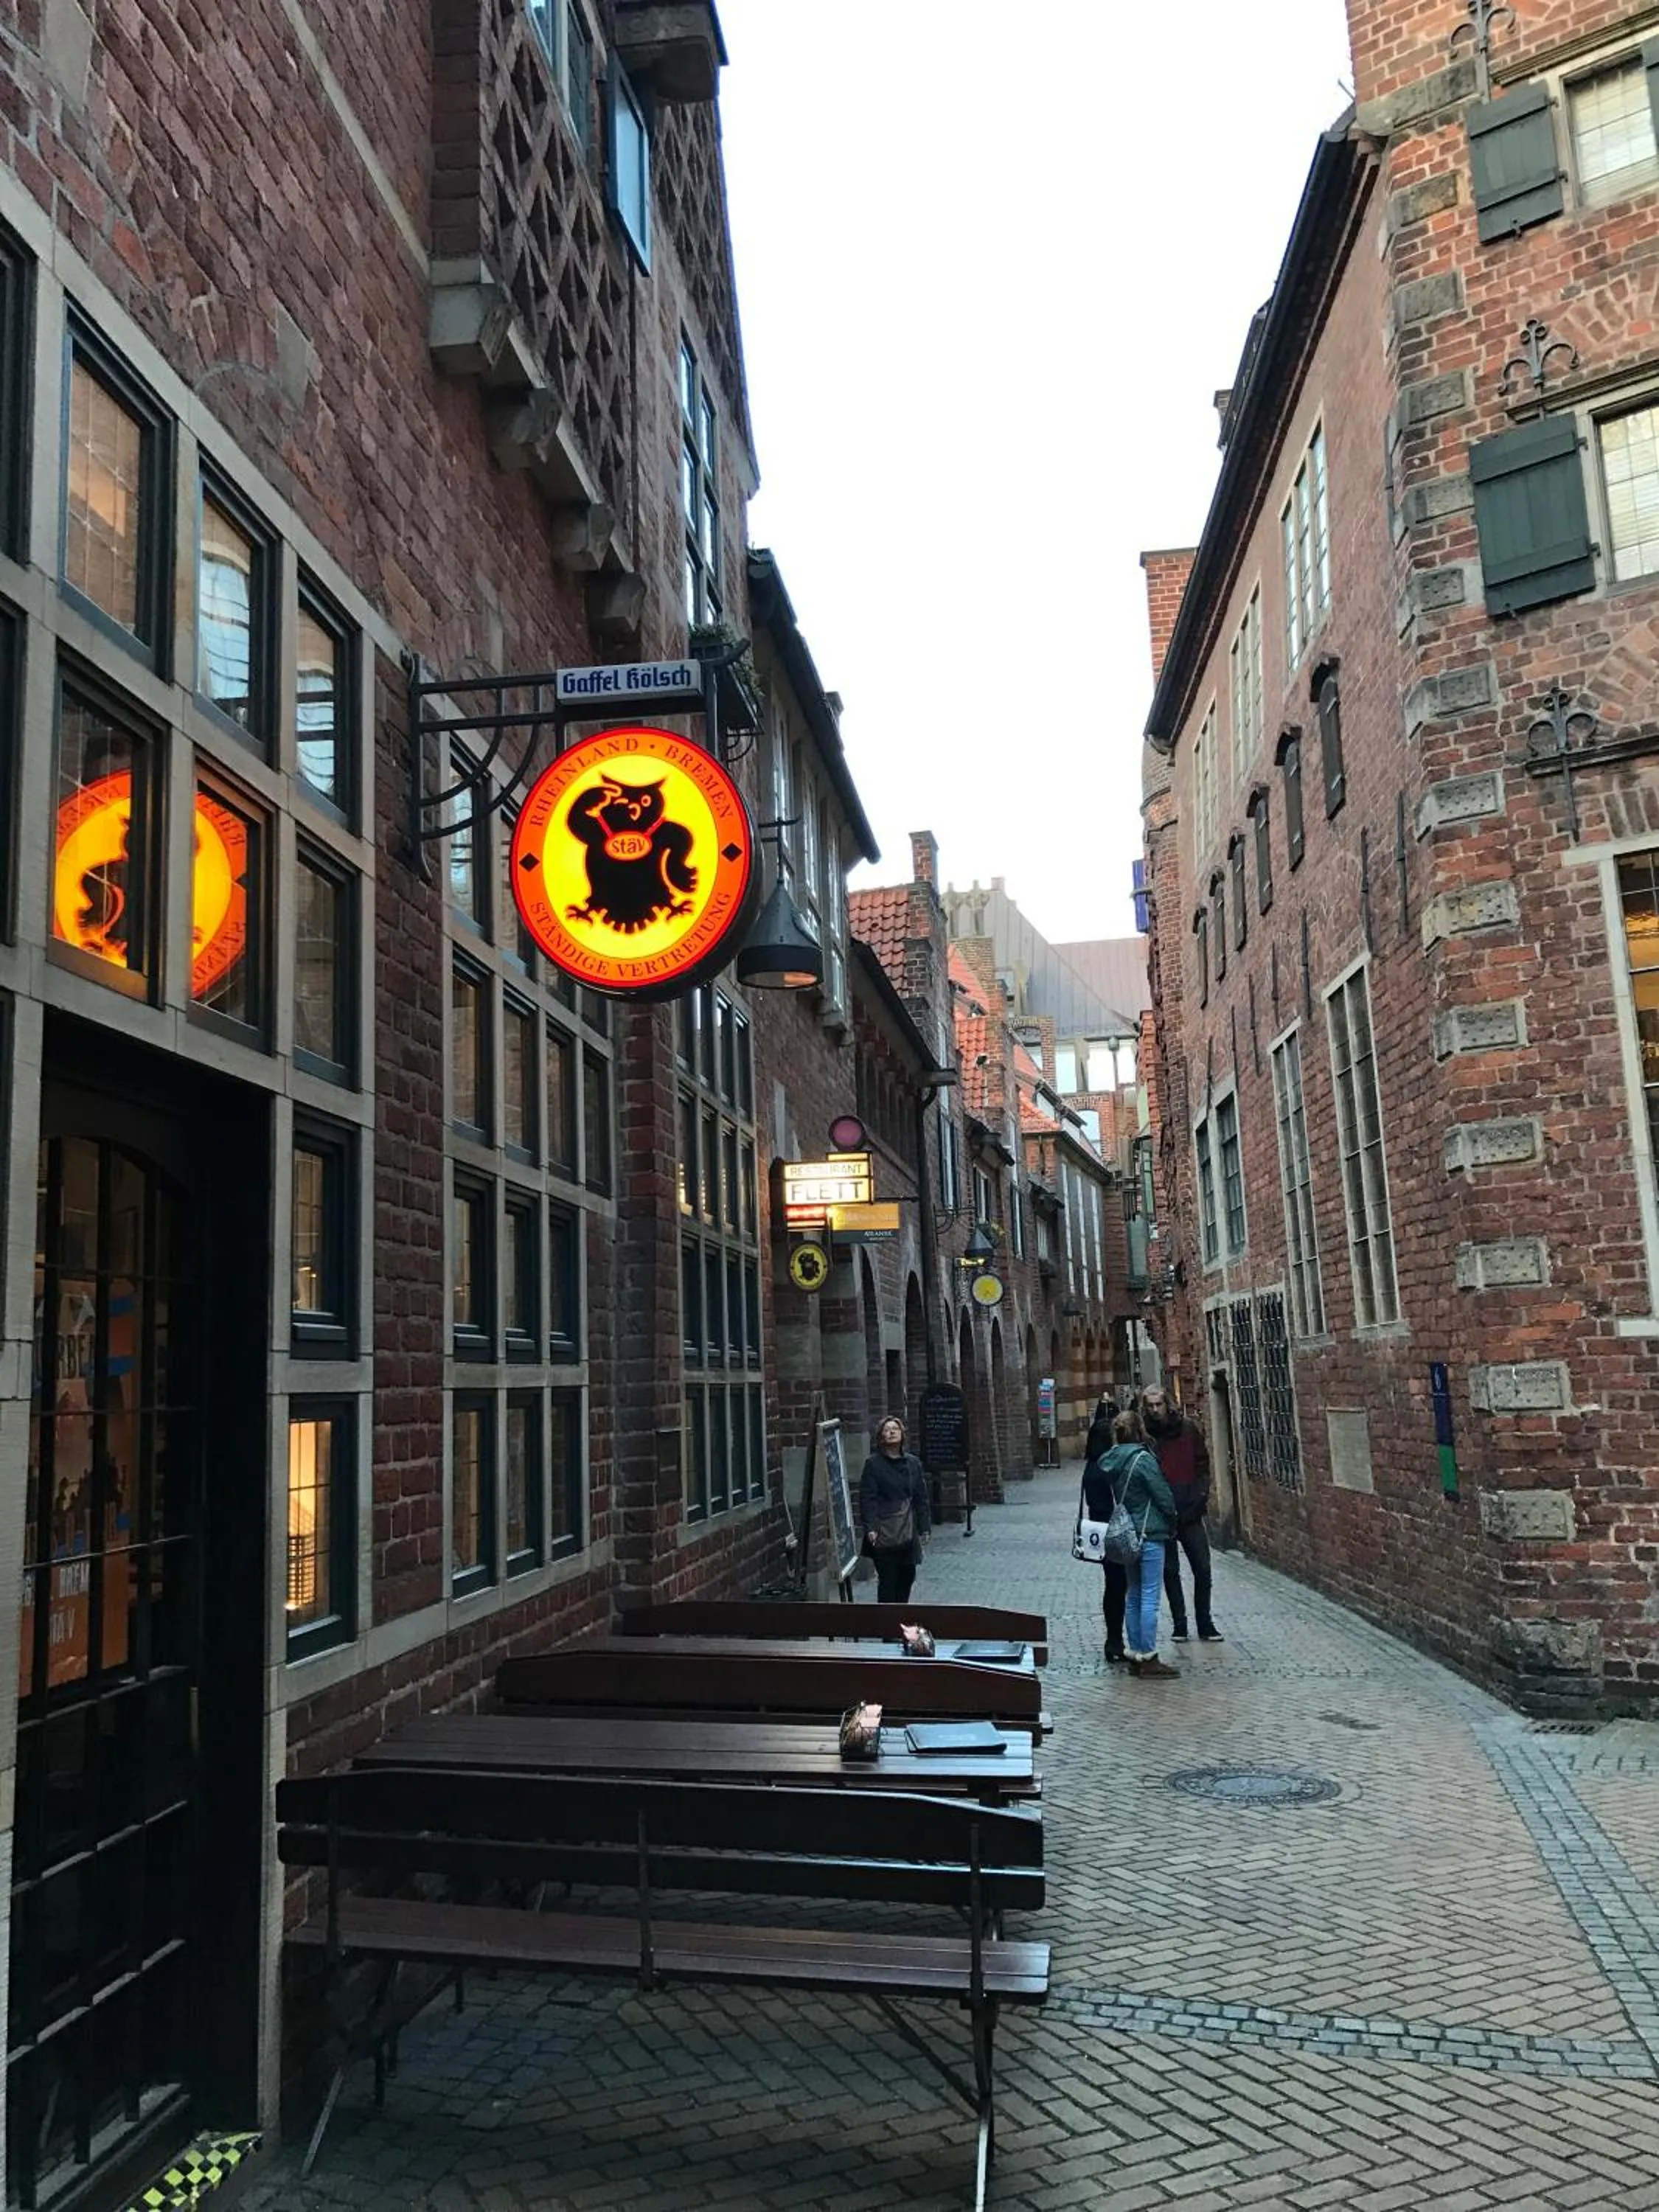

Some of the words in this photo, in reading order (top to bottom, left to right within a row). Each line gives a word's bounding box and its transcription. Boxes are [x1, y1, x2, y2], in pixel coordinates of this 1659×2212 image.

[563, 669, 621, 693] Gaffel
[627, 664, 692, 689] Kölsch
[530, 738, 639, 827] RHEINLAND
[665, 745, 734, 819] BREMEN
[530, 902, 609, 975] STÄNDIGE
[617, 892, 731, 977] VERTRETUNG
[791, 1182, 863, 1201] FLETT
